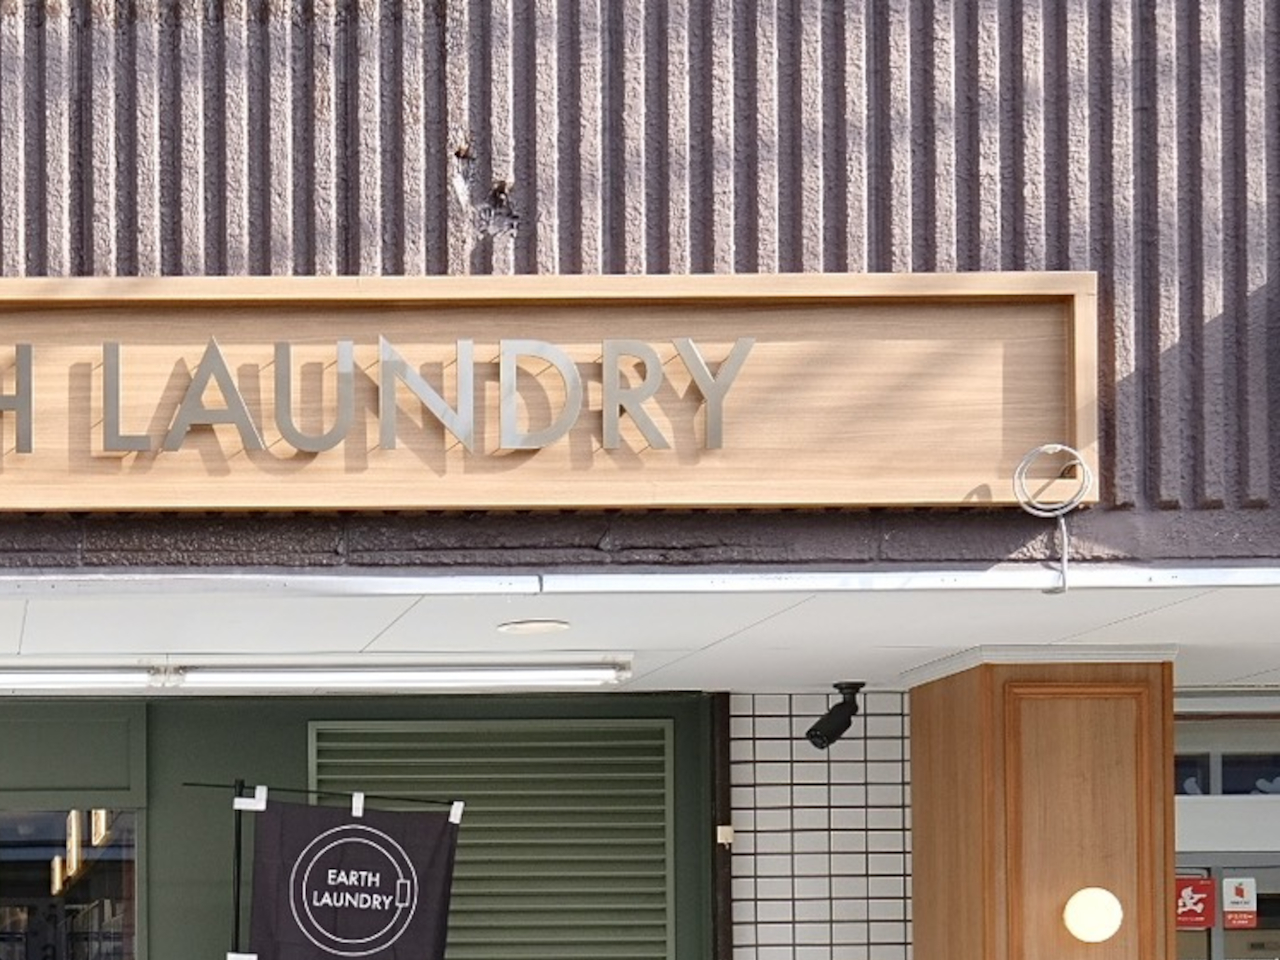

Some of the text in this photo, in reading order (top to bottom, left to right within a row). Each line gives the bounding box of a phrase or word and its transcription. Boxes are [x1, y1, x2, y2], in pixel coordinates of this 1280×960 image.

[102, 335, 757, 455] LAUNDRY
[327, 869, 380, 887] EARTH
[312, 891, 394, 910] LAUNDRY
